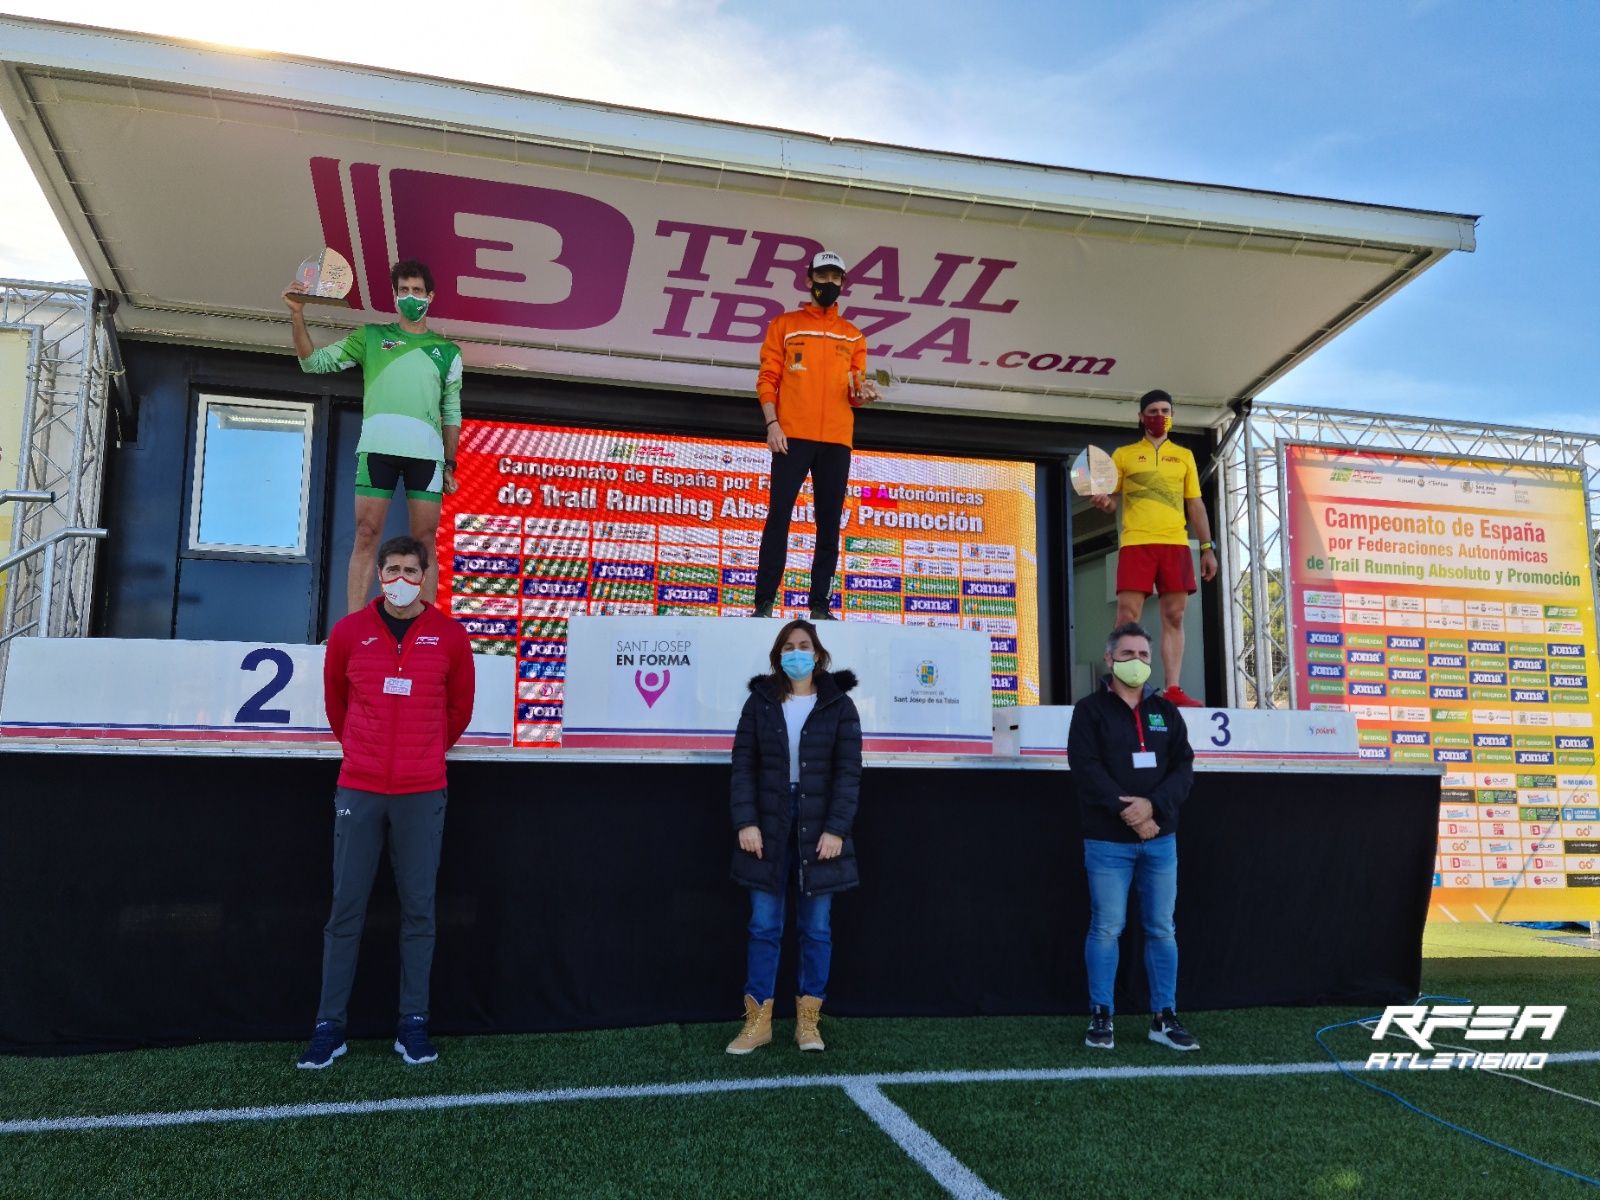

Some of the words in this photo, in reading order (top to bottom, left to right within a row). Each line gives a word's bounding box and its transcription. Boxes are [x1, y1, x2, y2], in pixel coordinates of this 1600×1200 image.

[656, 218, 1018, 315] TRAIL
[499, 457, 618, 481] Campeonato
[624, 467, 646, 483] de
[652, 469, 717, 489] España
[723, 475, 750, 492] por
[876, 484, 984, 506] Autonómicas
[498, 482, 532, 506] de
[540, 485, 597, 509] Trail
[606, 489, 714, 521] Running
[858, 506, 984, 533] Promoción
[1325, 508, 1446, 537] Campeonato
[1452, 517, 1474, 537] de
[1480, 519, 1545, 544] España
[1328, 537, 1352, 552] por
[1358, 537, 1454, 557] Federaciones
[1459, 543, 1548, 563] Autonómicas
[1307, 555, 1324, 571] de
[1328, 557, 1360, 573] Trail
[1365, 559, 1425, 580] Running
[1429, 563, 1490, 581] Absoluto
[1496, 569, 1503, 585] y
[1507, 568, 1581, 587] Promoción
[616, 640, 649, 652] SANT
[652, 640, 692, 652] JOSEP
[616, 654, 634, 666] EN
[639, 654, 691, 666] FORMA
[234, 648, 294, 723] 2
[1211, 711, 1232, 747] 3
